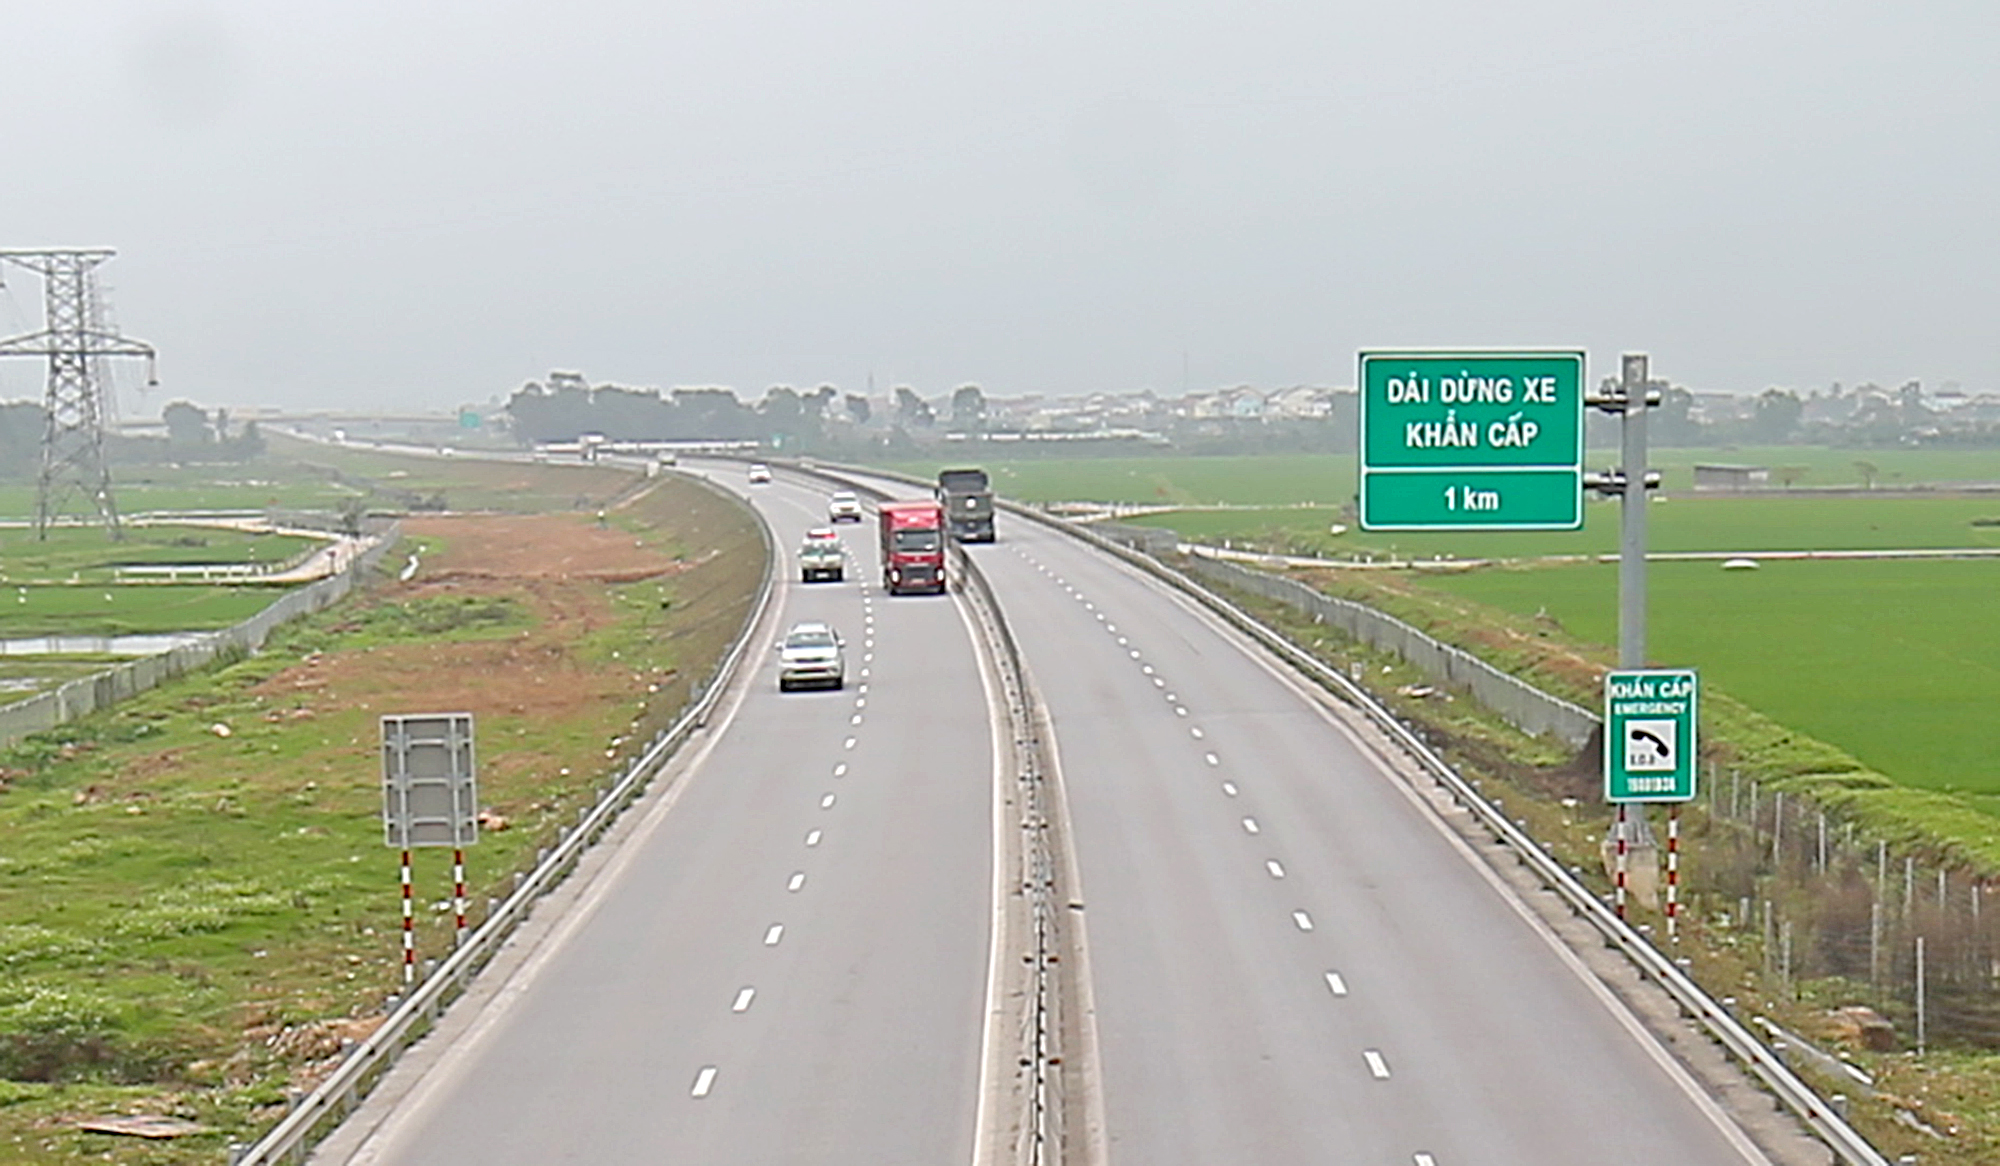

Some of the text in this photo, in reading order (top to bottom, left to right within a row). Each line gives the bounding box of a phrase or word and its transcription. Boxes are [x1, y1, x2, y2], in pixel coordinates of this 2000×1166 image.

[1387, 369, 1557, 404] DẢI DỪNG XE
[1405, 408, 1539, 448] KHẨN CẤP
[1444, 486, 1499, 510] 1 km
